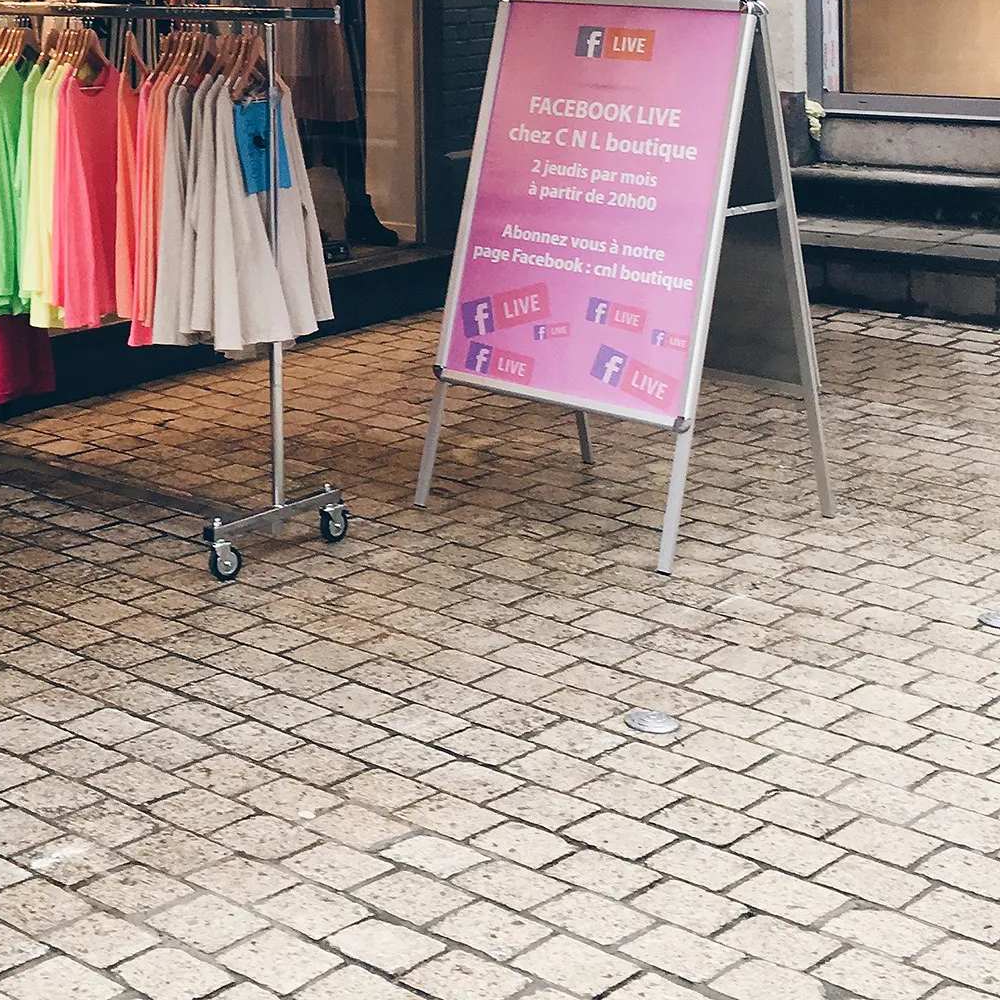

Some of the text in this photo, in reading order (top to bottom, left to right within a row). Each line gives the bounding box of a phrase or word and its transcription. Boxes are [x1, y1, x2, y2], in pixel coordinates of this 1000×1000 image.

[612, 36, 646, 54] LIVE
[529, 96, 682, 128] FACEBOOK LIVE
[508, 123, 698, 163] chez C N L boutique
[531, 159, 658, 187] 2 jeudis par mois
[528, 181, 657, 211] à partir de 20h00
[502, 223, 665, 262] Abonnez vous à notre
[473, 245, 510, 264] page
[512, 248, 583, 275] Facebook
[594, 262, 617, 279] cnl
[620, 265, 694, 291] boutique
[503, 294, 541, 319] LIVE
[614, 310, 641, 327] LIVE
[550, 326, 567, 335] LIVE
[669, 337, 687, 348] LIVE
[498, 357, 527, 377] LIVE
[631, 370, 668, 400] LIVE
